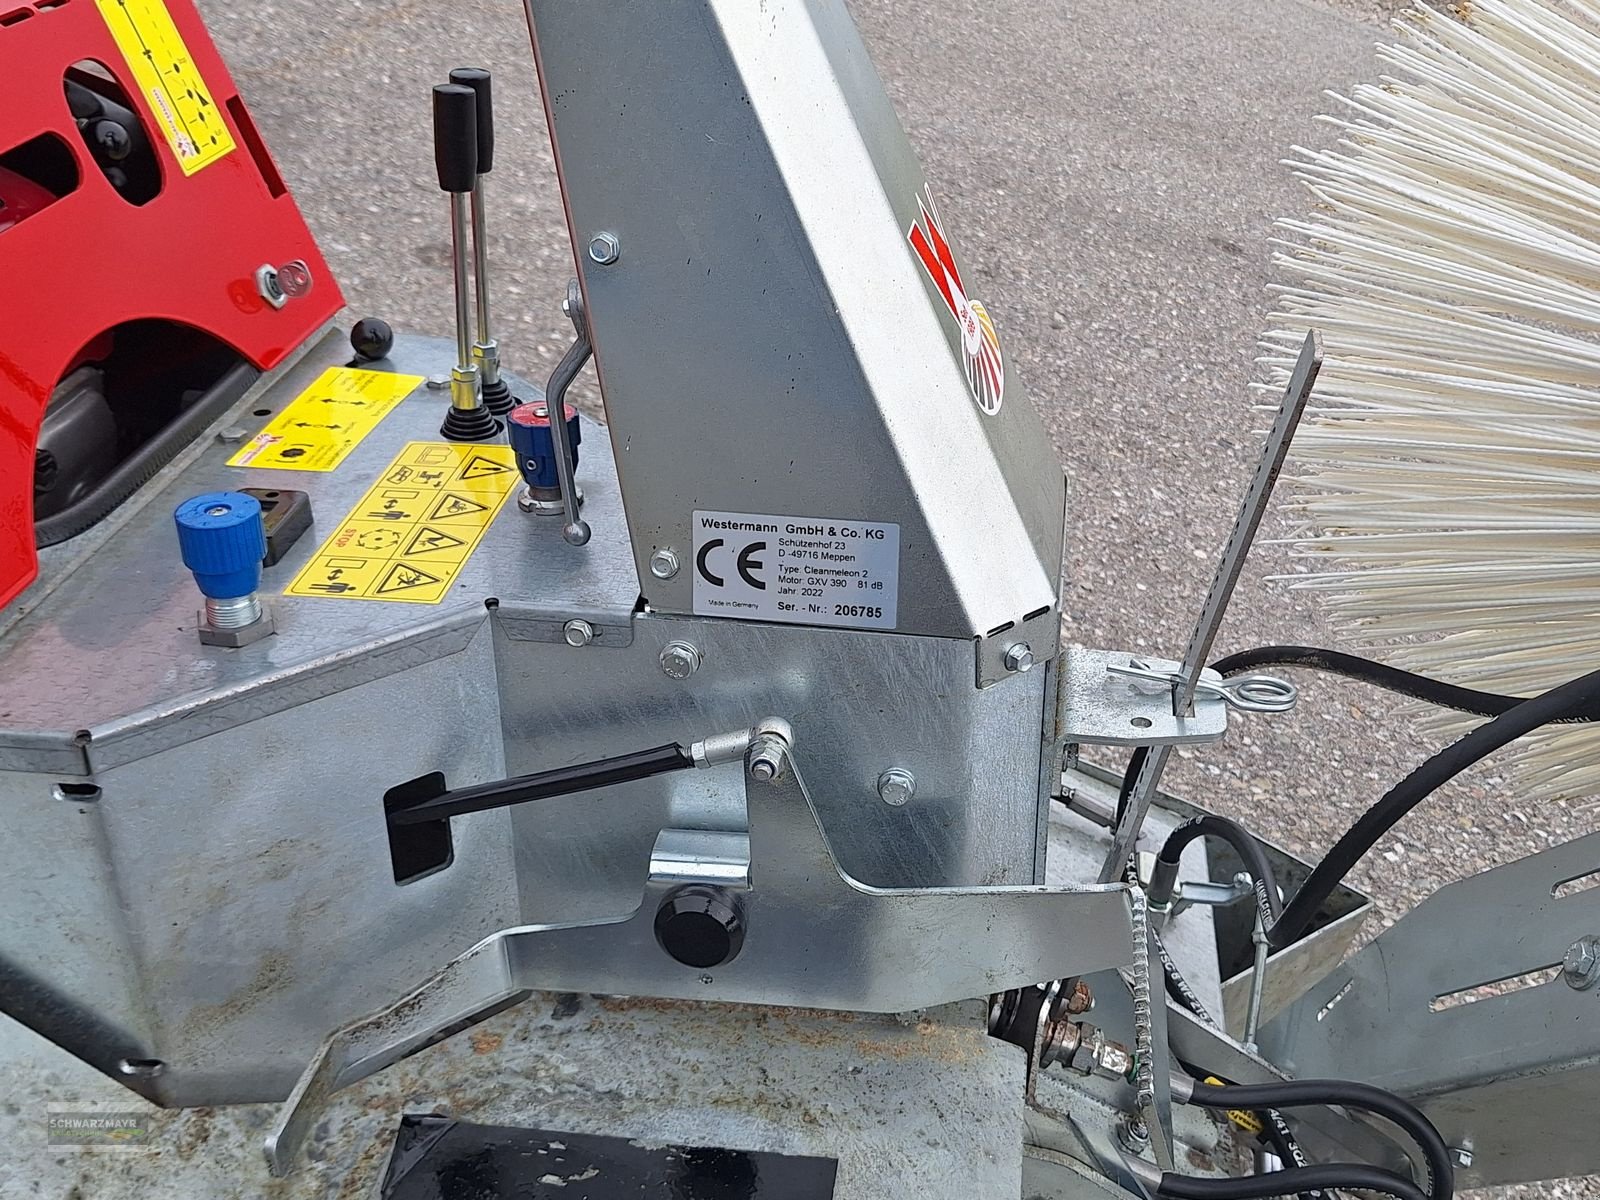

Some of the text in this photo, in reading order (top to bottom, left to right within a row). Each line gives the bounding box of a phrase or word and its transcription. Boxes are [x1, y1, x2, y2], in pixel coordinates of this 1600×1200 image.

[701, 518, 885, 540] Westermann GmbH & Co. KG
[335, 528, 357, 548] STOP
[778, 538, 846, 550] Schützenhof 23
[820, 552, 856, 563] Meppen
[778, 564, 869, 578] Type: Cleanmeleon 2
[778, 576, 883, 590] Motor: GXV 390 81 dB
[777, 587, 823, 597] Jahr: 2022
[708, 599, 724, 607] Made
[732, 601, 759, 610] Germany
[777, 602, 799, 612] Ser.
[808, 604, 828, 614] Nr.:
[834, 605, 882, 618] 206785
